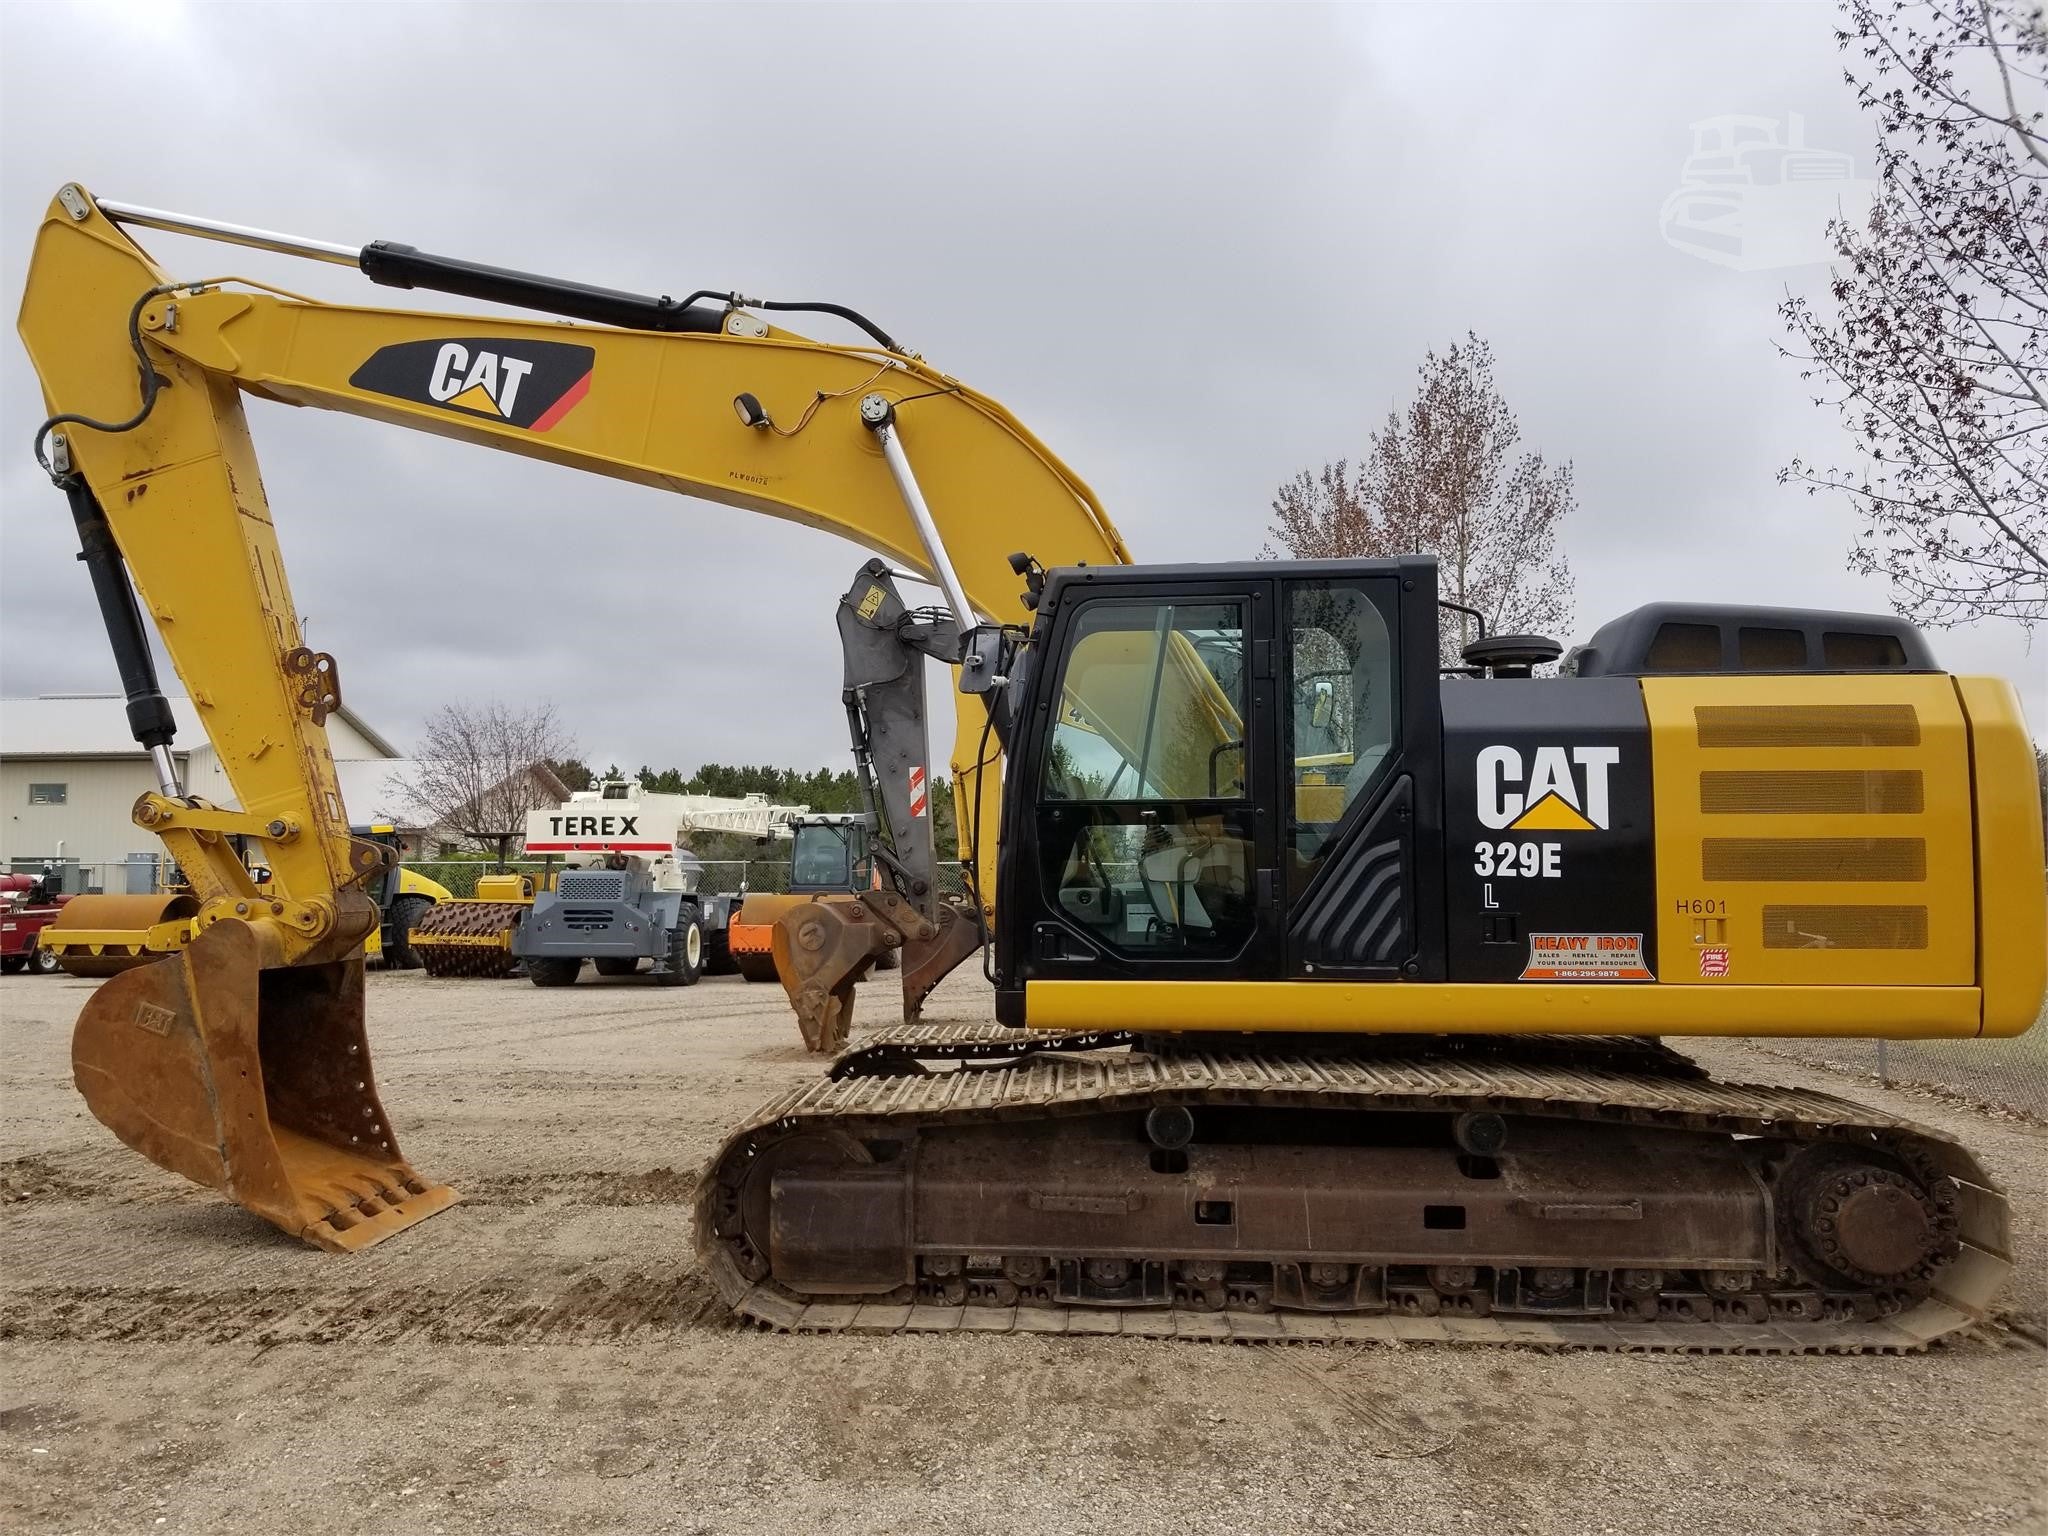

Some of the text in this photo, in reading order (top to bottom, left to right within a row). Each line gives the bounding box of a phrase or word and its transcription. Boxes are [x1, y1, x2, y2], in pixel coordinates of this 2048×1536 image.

[428, 342, 534, 419] CAT
[1476, 745, 1620, 830] CAT
[549, 815, 639, 836] TEREX
[1474, 841, 1562, 877] 329E
[1484, 883, 1499, 908] L
[1676, 899, 1727, 914] H601
[1534, 936, 1638, 950] HEAVY IRON
